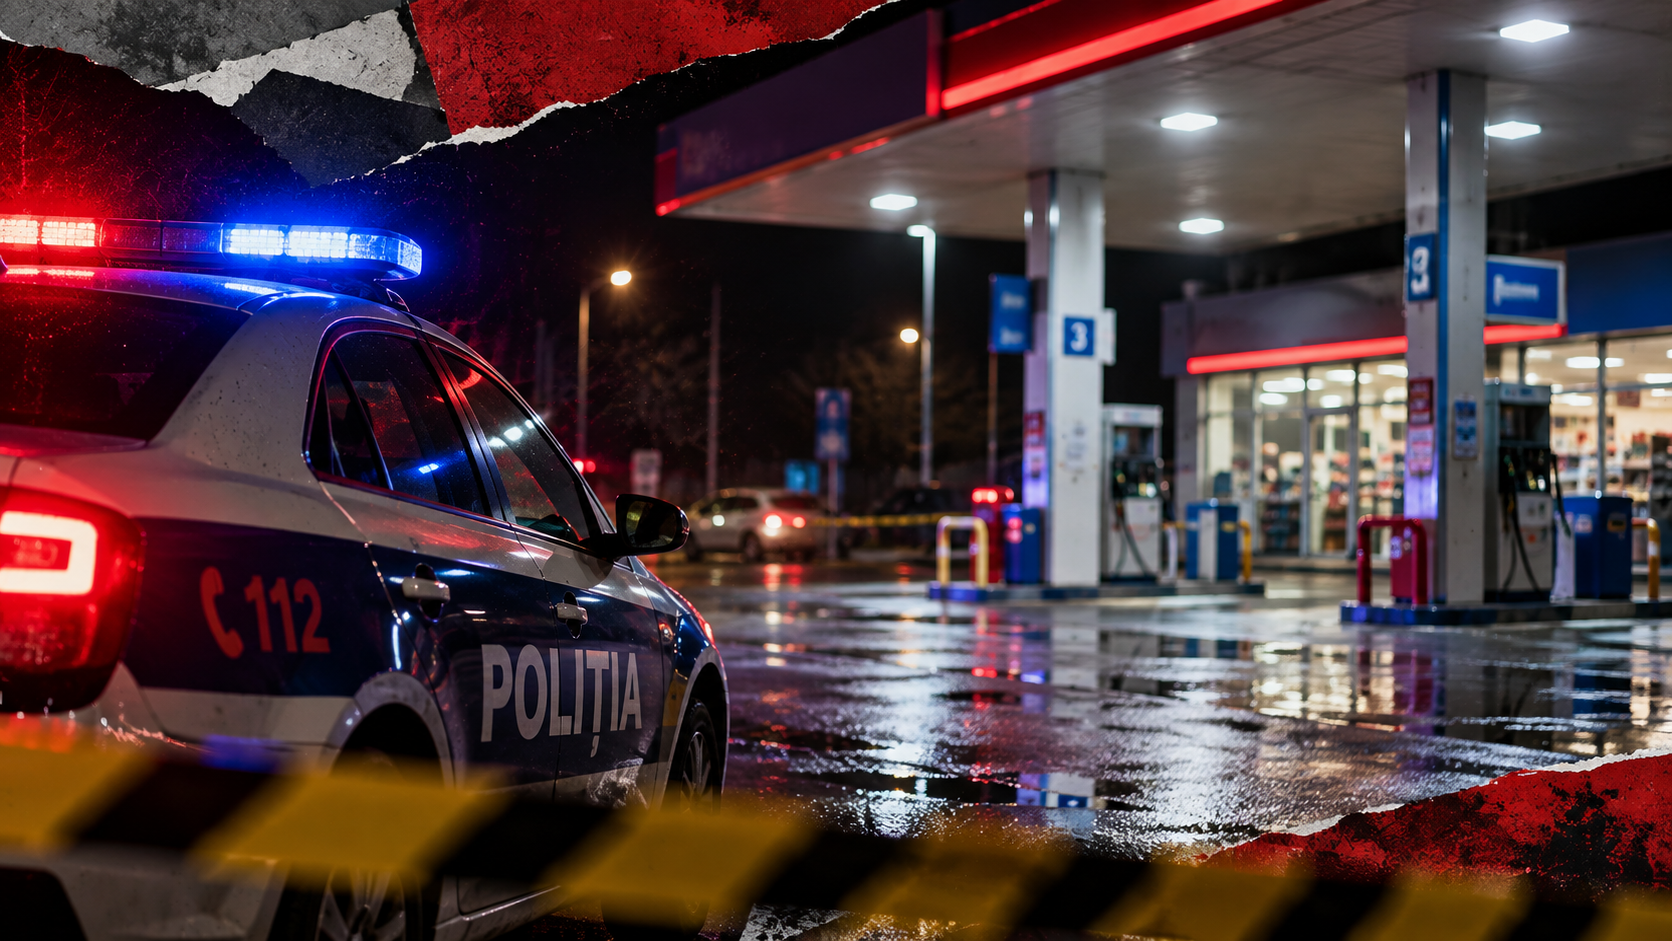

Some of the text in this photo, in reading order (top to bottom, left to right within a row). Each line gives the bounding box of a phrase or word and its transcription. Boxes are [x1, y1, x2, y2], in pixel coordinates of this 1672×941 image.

[1070, 321, 1088, 352] 3
[244, 575, 331, 653] 112
[481, 644, 642, 758] POLIȚIA
